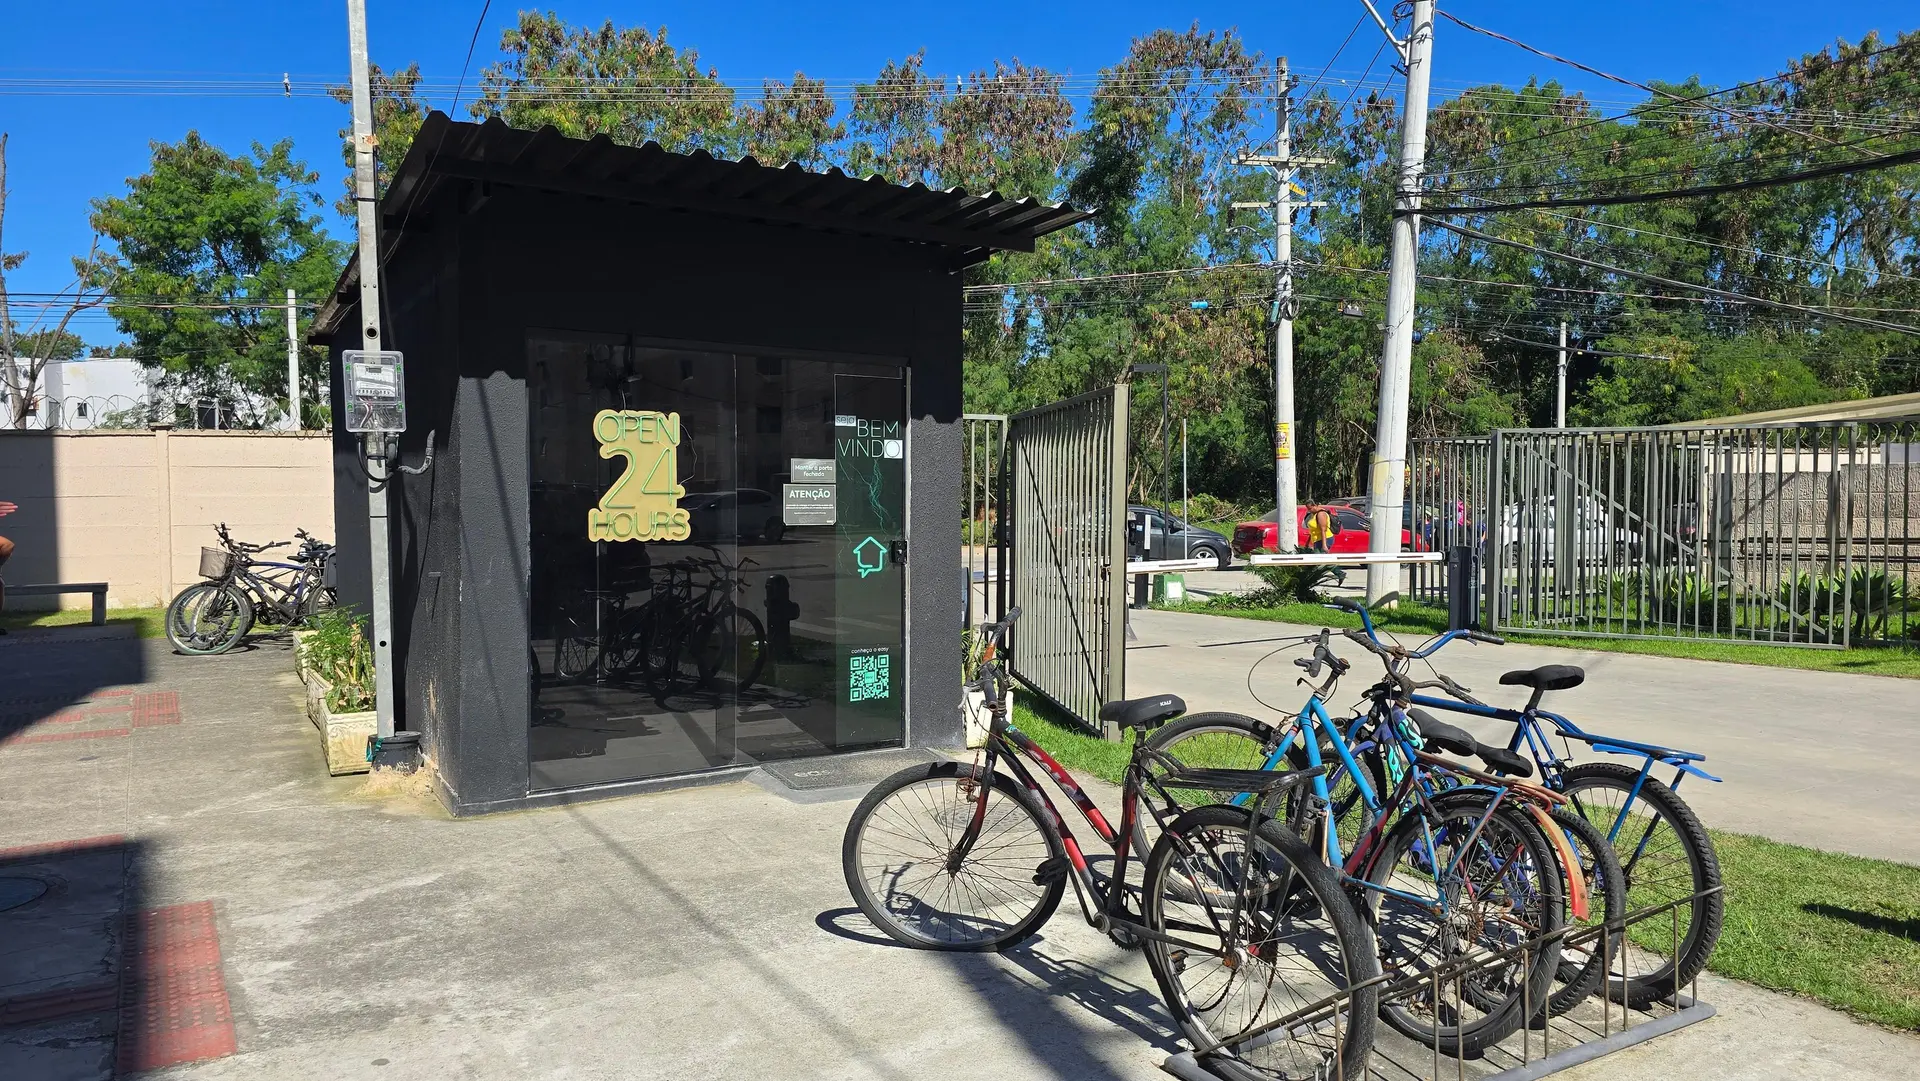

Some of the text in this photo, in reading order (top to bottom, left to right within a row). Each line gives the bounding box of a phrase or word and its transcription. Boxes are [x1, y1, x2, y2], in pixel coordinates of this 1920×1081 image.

[598, 414, 677, 444] OPEN
[857, 418, 899, 438] BEM
[837, 438, 901, 458] VINDO
[603, 447, 681, 508] 24
[789, 488, 831, 500] ATENÇÃO
[593, 511, 687, 537] HOURS
